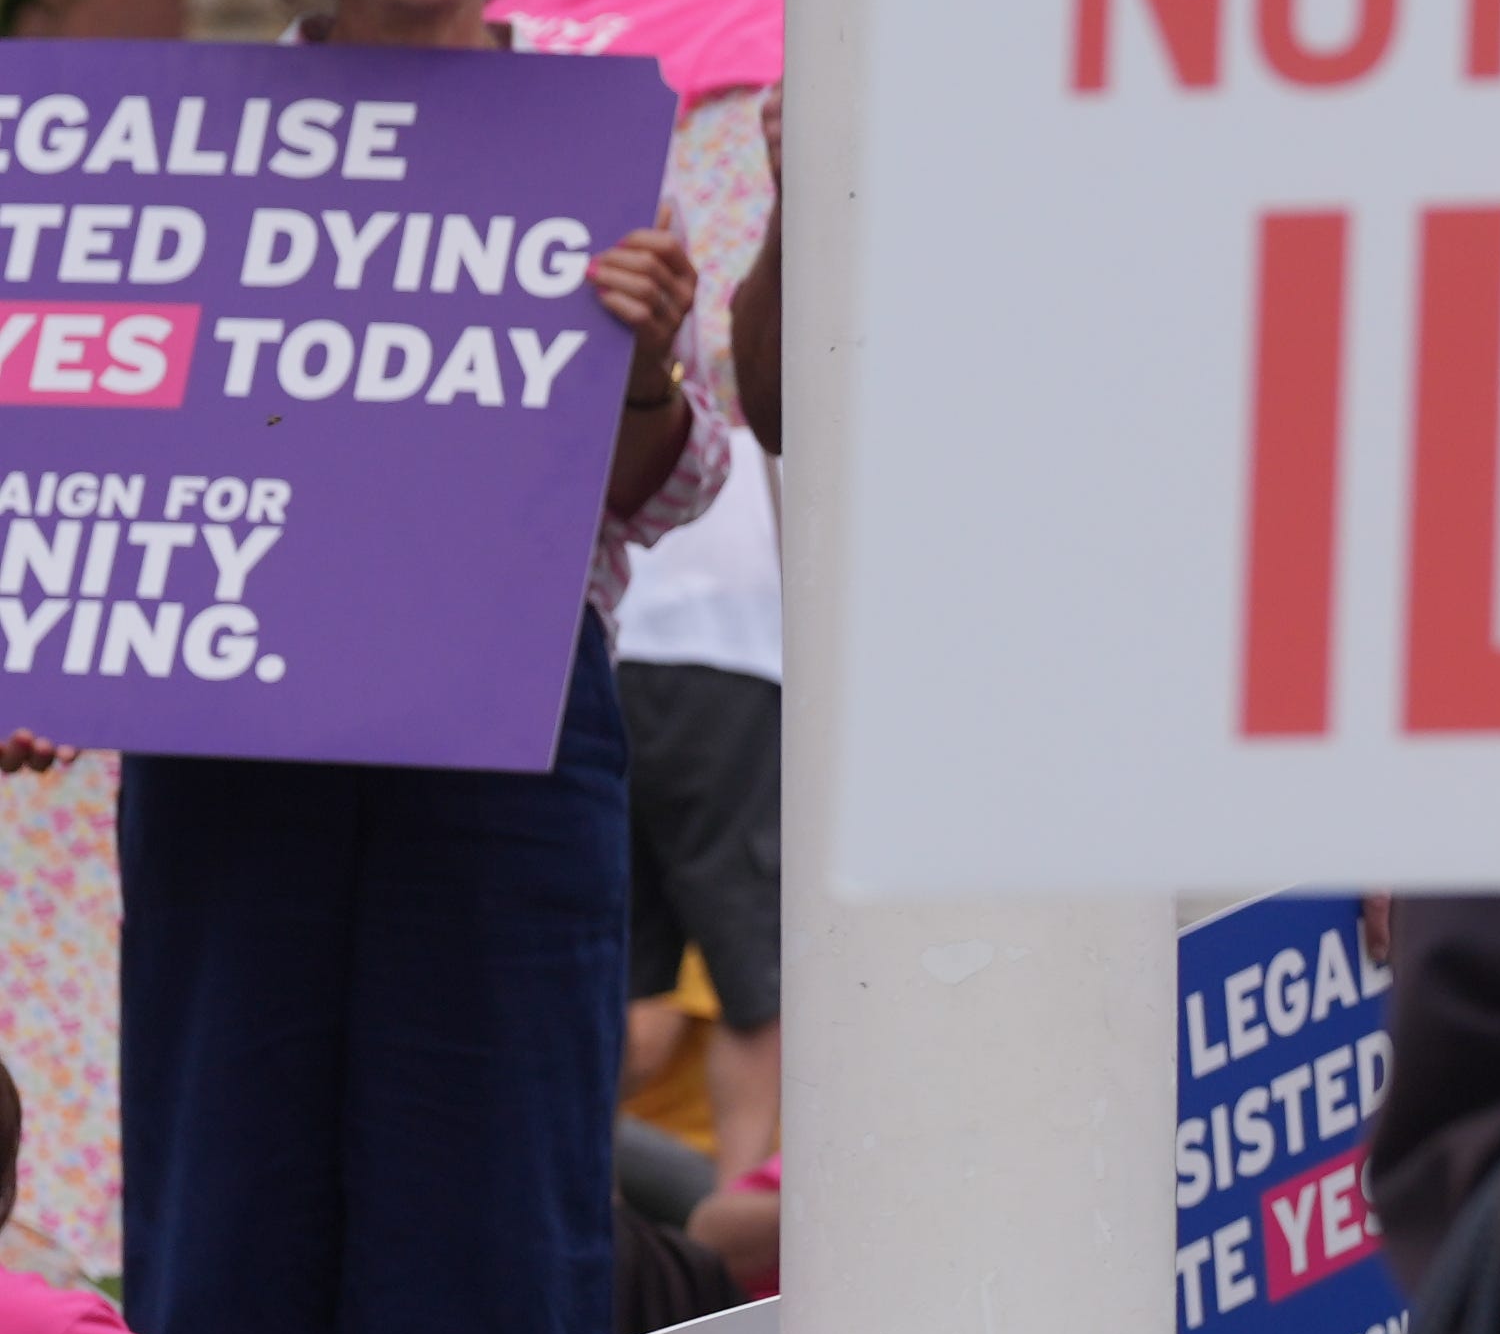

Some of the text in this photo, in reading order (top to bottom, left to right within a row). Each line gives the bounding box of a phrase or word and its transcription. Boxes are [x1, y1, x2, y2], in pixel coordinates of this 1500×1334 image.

[240, 207, 592, 299] DYING
[214, 317, 589, 409] TODAY
[164, 476, 293, 525] FOR
